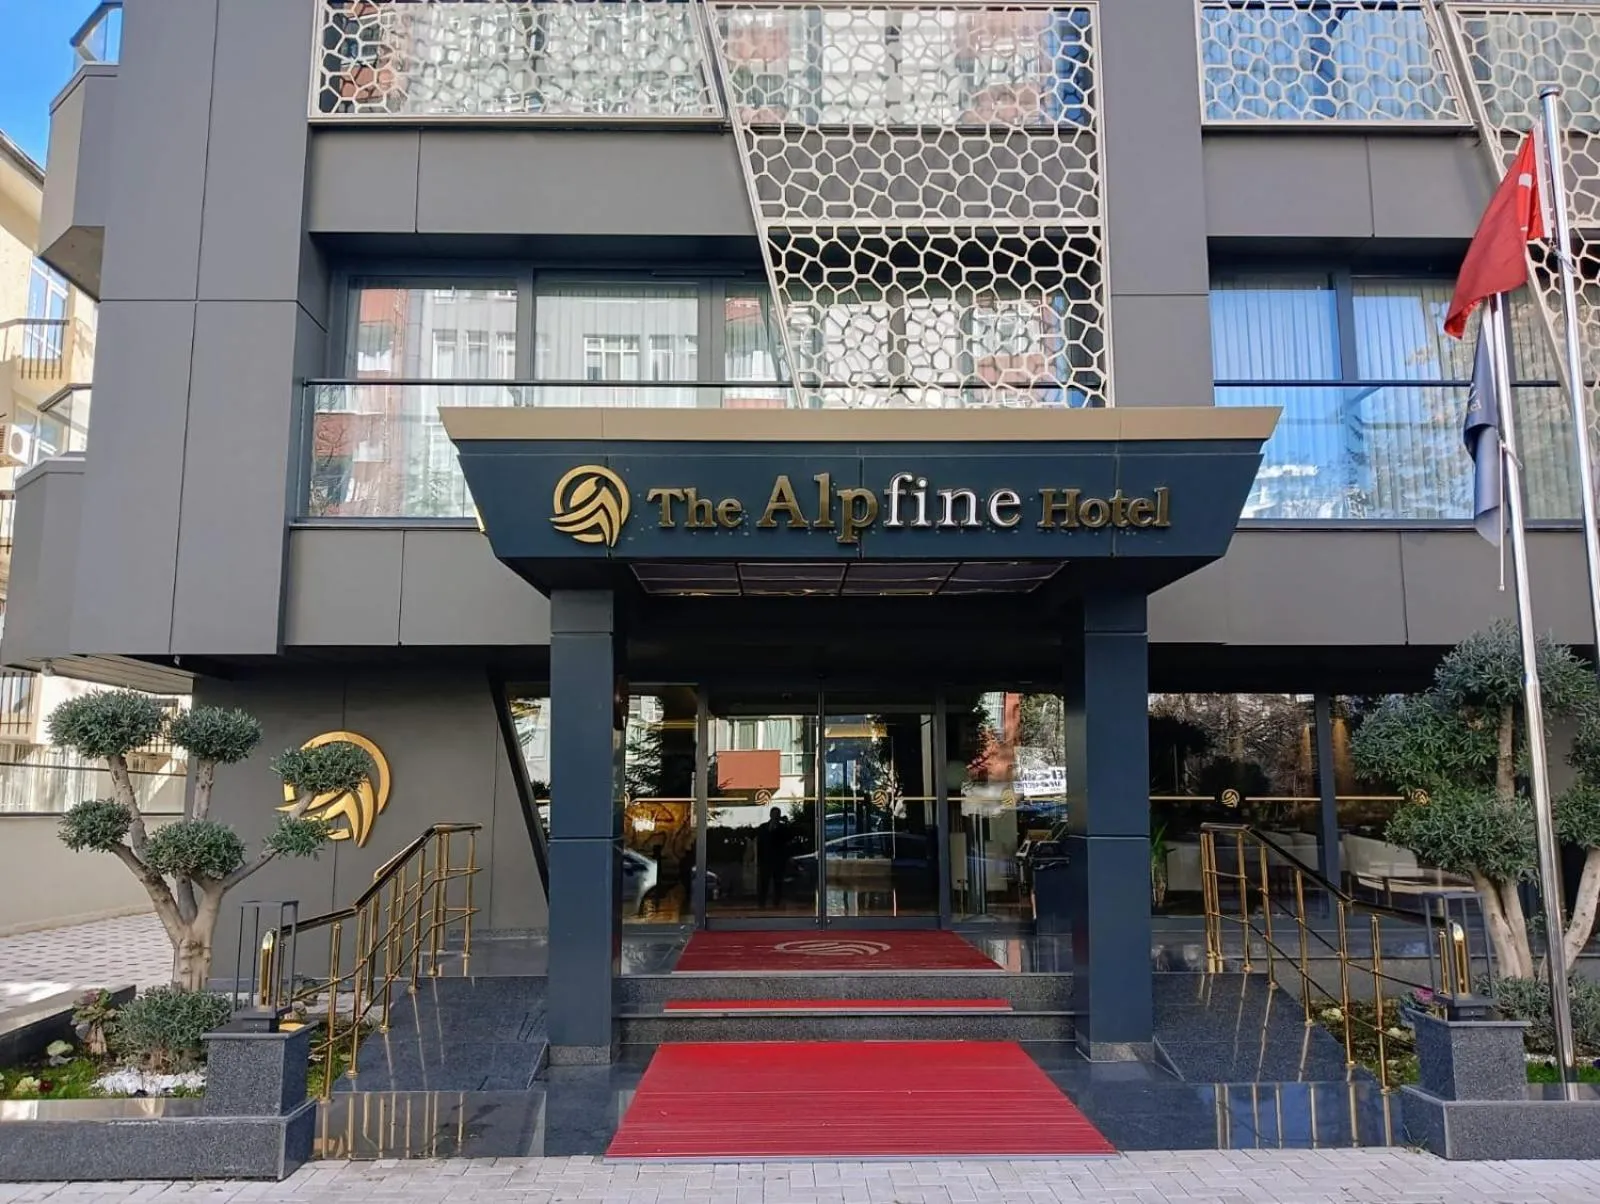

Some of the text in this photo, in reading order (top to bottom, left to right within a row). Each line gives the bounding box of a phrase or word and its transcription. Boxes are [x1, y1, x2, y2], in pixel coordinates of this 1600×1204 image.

[647, 472, 1171, 543] The Alpfine Hotel
